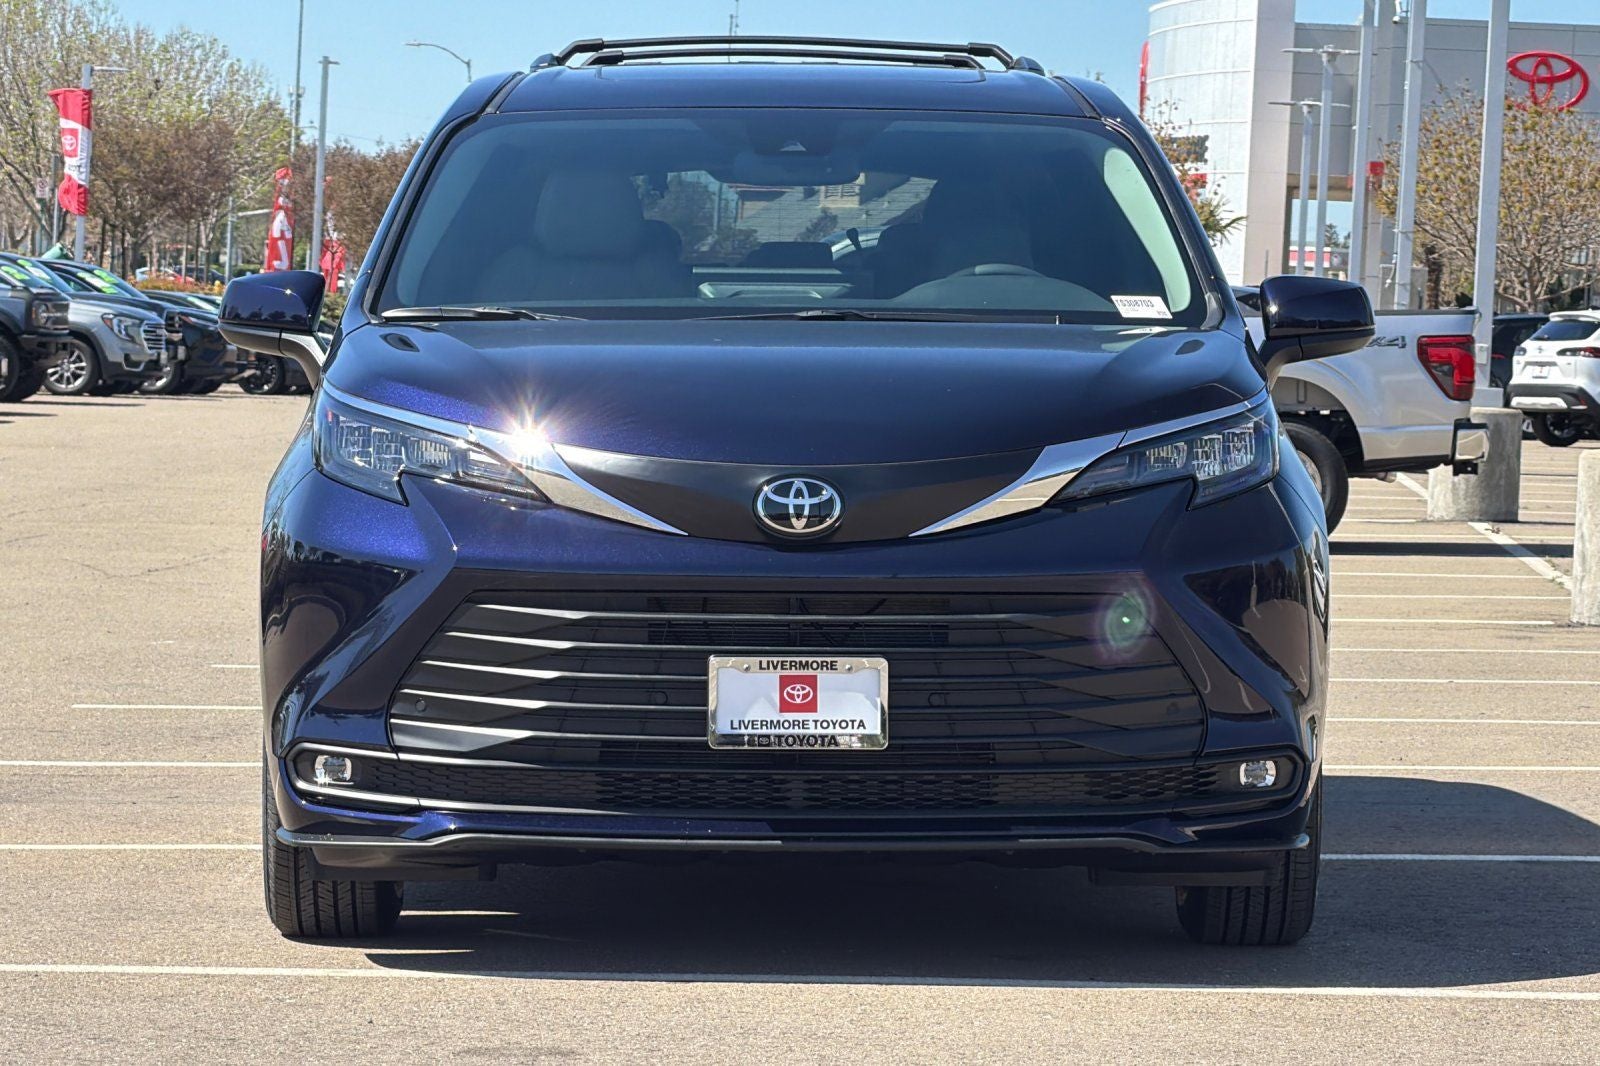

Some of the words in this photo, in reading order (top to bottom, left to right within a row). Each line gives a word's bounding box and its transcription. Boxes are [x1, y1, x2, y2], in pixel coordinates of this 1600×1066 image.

[1366, 335, 1407, 348] X4
[759, 660, 838, 671] LIVERMORE
[730, 719, 810, 730] LIVERMORE
[812, 719, 866, 730] TOYOTA
[776, 735, 838, 747] TOYOTA
